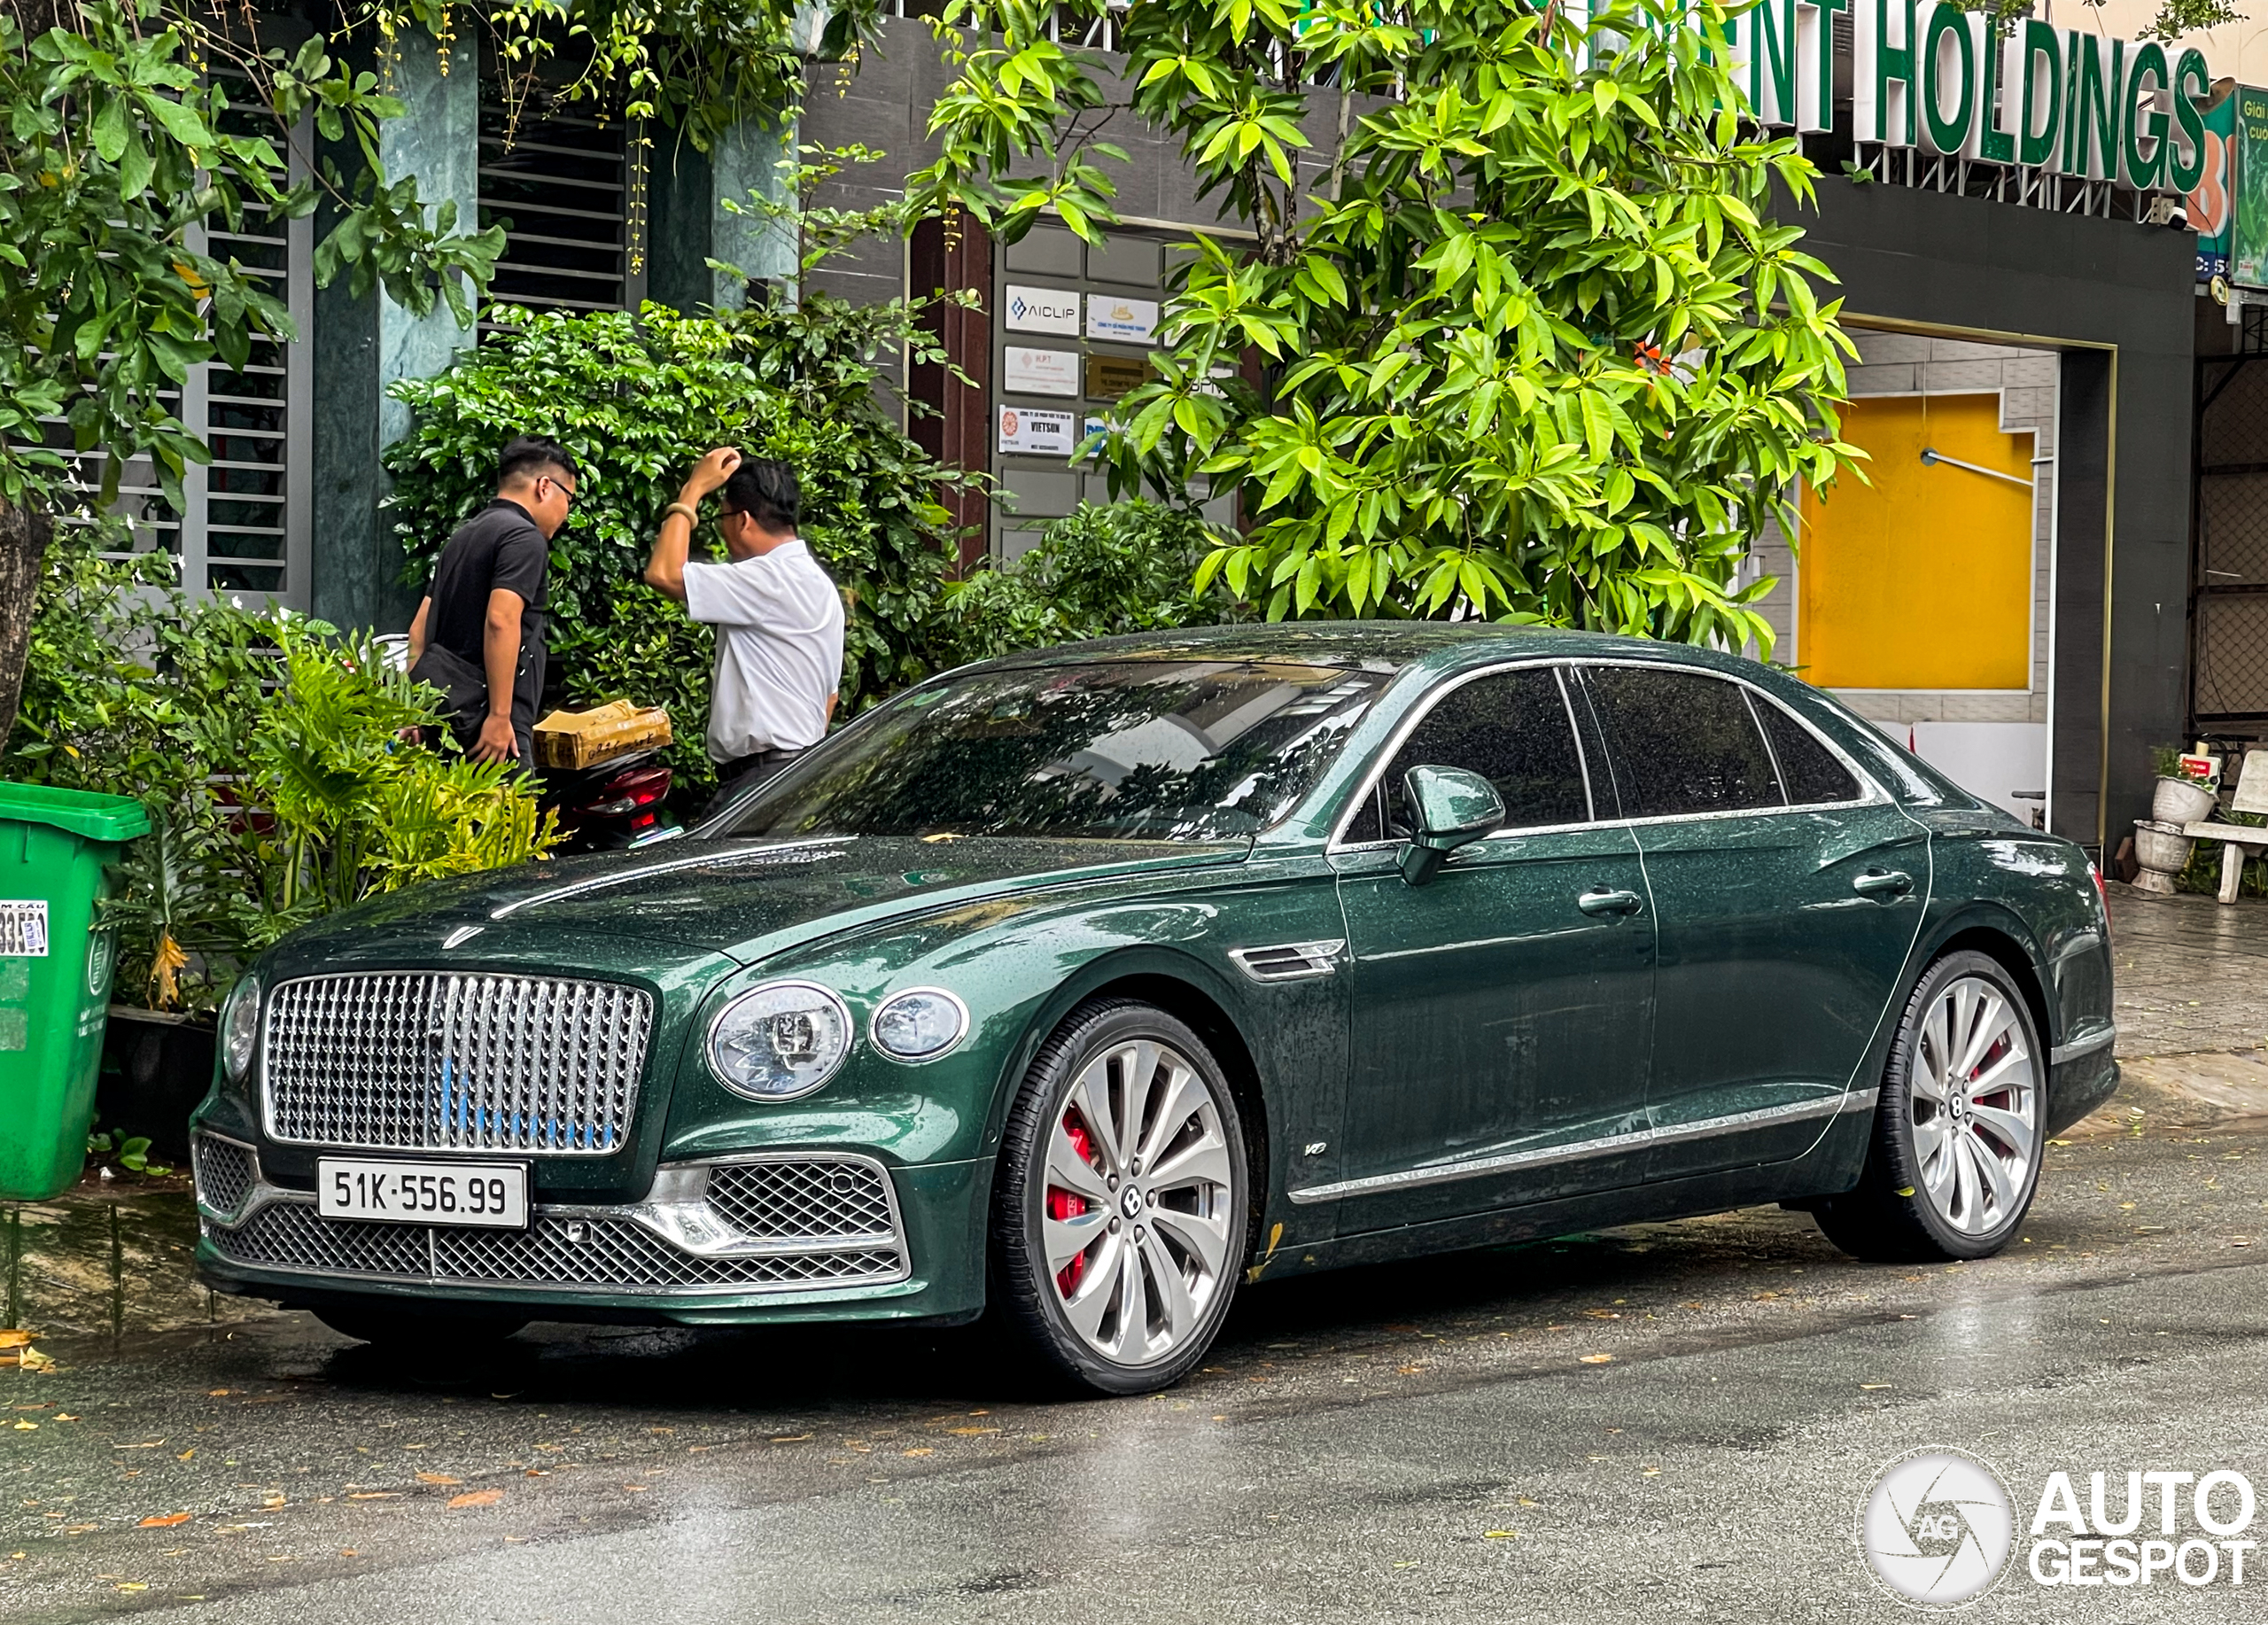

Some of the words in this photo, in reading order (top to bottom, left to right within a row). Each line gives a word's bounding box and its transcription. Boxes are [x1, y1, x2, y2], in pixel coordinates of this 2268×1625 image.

[1853, 0, 2211, 194] HOLDINGS
[1029, 305, 1076, 319] AICLIP
[1030, 422, 1060, 433] VIETSUN
[335, 1171, 506, 1215] 51K-556.99
